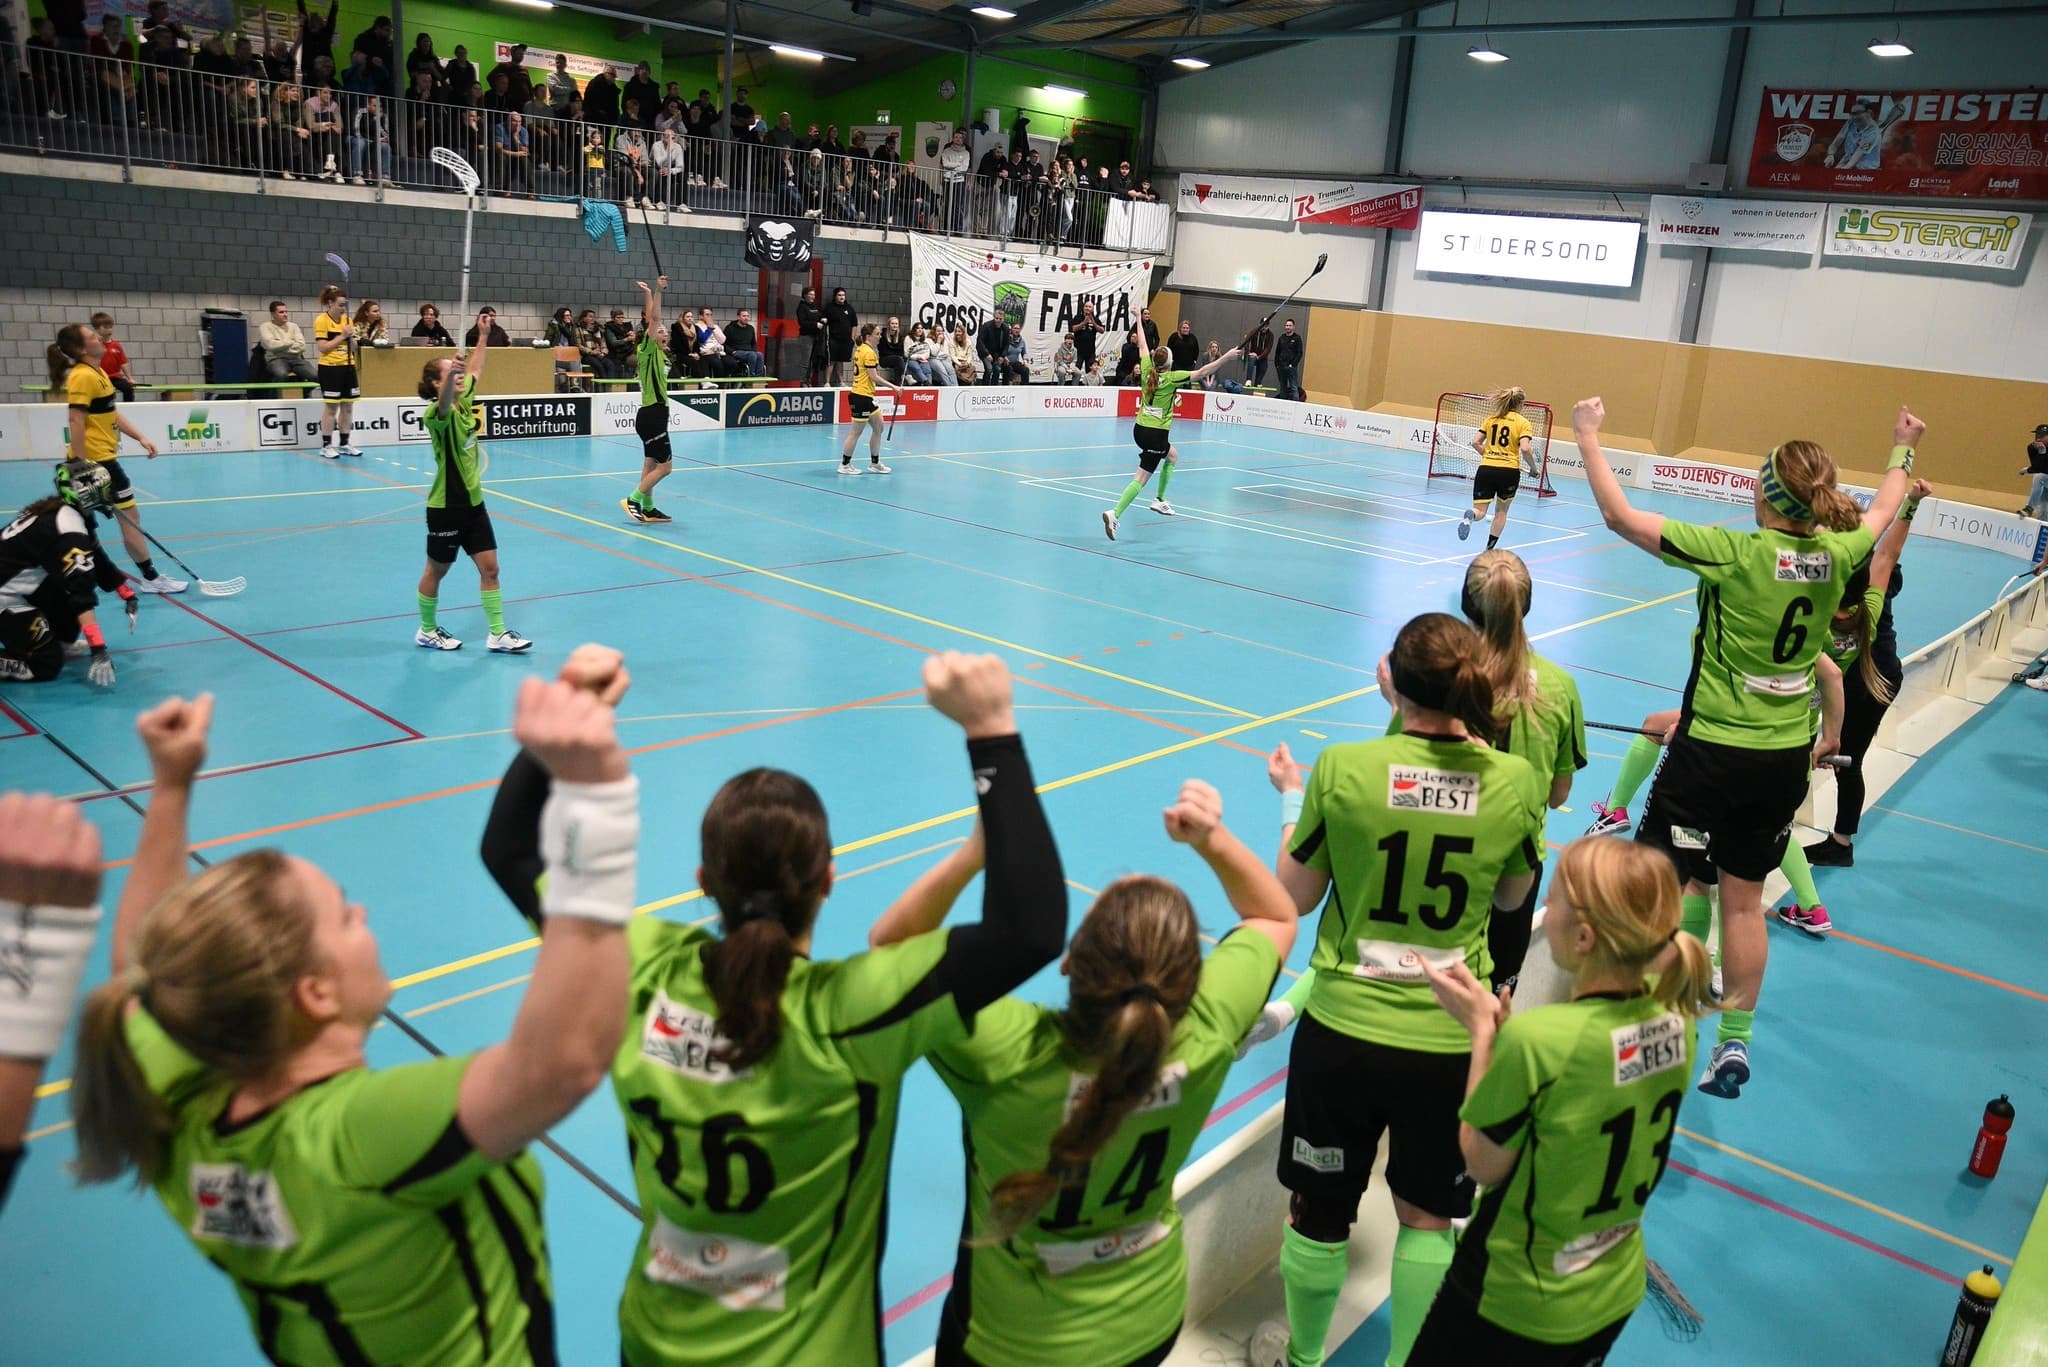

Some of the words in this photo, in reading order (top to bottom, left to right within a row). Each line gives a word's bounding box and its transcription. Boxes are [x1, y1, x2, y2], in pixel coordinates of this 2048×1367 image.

[1938, 132, 2033, 150] NORINA
[1934, 149, 2043, 167] REUSSER
[1987, 177, 2020, 190] Landi
[1731, 207, 1763, 218] wohnen
[1764, 208, 1774, 218] in
[1775, 209, 1818, 220] Uetendorf
[1675, 222, 1721, 237] HERZEN
[1733, 230, 1807, 242] www.imherzen.ch
[1833, 242, 1965, 261] Landtechnik
[1980, 252, 2006, 267] AG
[493, 403, 576, 419] SICHTBAR
[780, 396, 824, 413] ABAG
[262, 413, 294, 436] GT
[614, 416, 636, 428] von
[748, 414, 809, 425] Nutzfahrzeuge
[810, 413, 823, 423] AG
[1303, 412, 1333, 429] AEK
[168, 423, 222, 441] Landi
[493, 420, 577, 437] Beschriftung
[1410, 428, 1442, 447] AEK
[1490, 423, 1511, 448] 18
[1545, 455, 1576, 468] Schmid
[1618, 467, 1632, 477] AG
[1654, 466, 1679, 479] SOS
[1681, 467, 1729, 486] DIENST
[1938, 513, 1993, 537] TRION
[1995, 524, 2034, 548] IMMO
[1773, 596, 1813, 664] 6
[1421, 786, 1474, 811] BEST
[1368, 830, 1475, 931] 15
[1642, 1033, 1683, 1072] BEST
[629, 1096, 776, 1215] 16
[1582, 1089, 1683, 1220] 13
